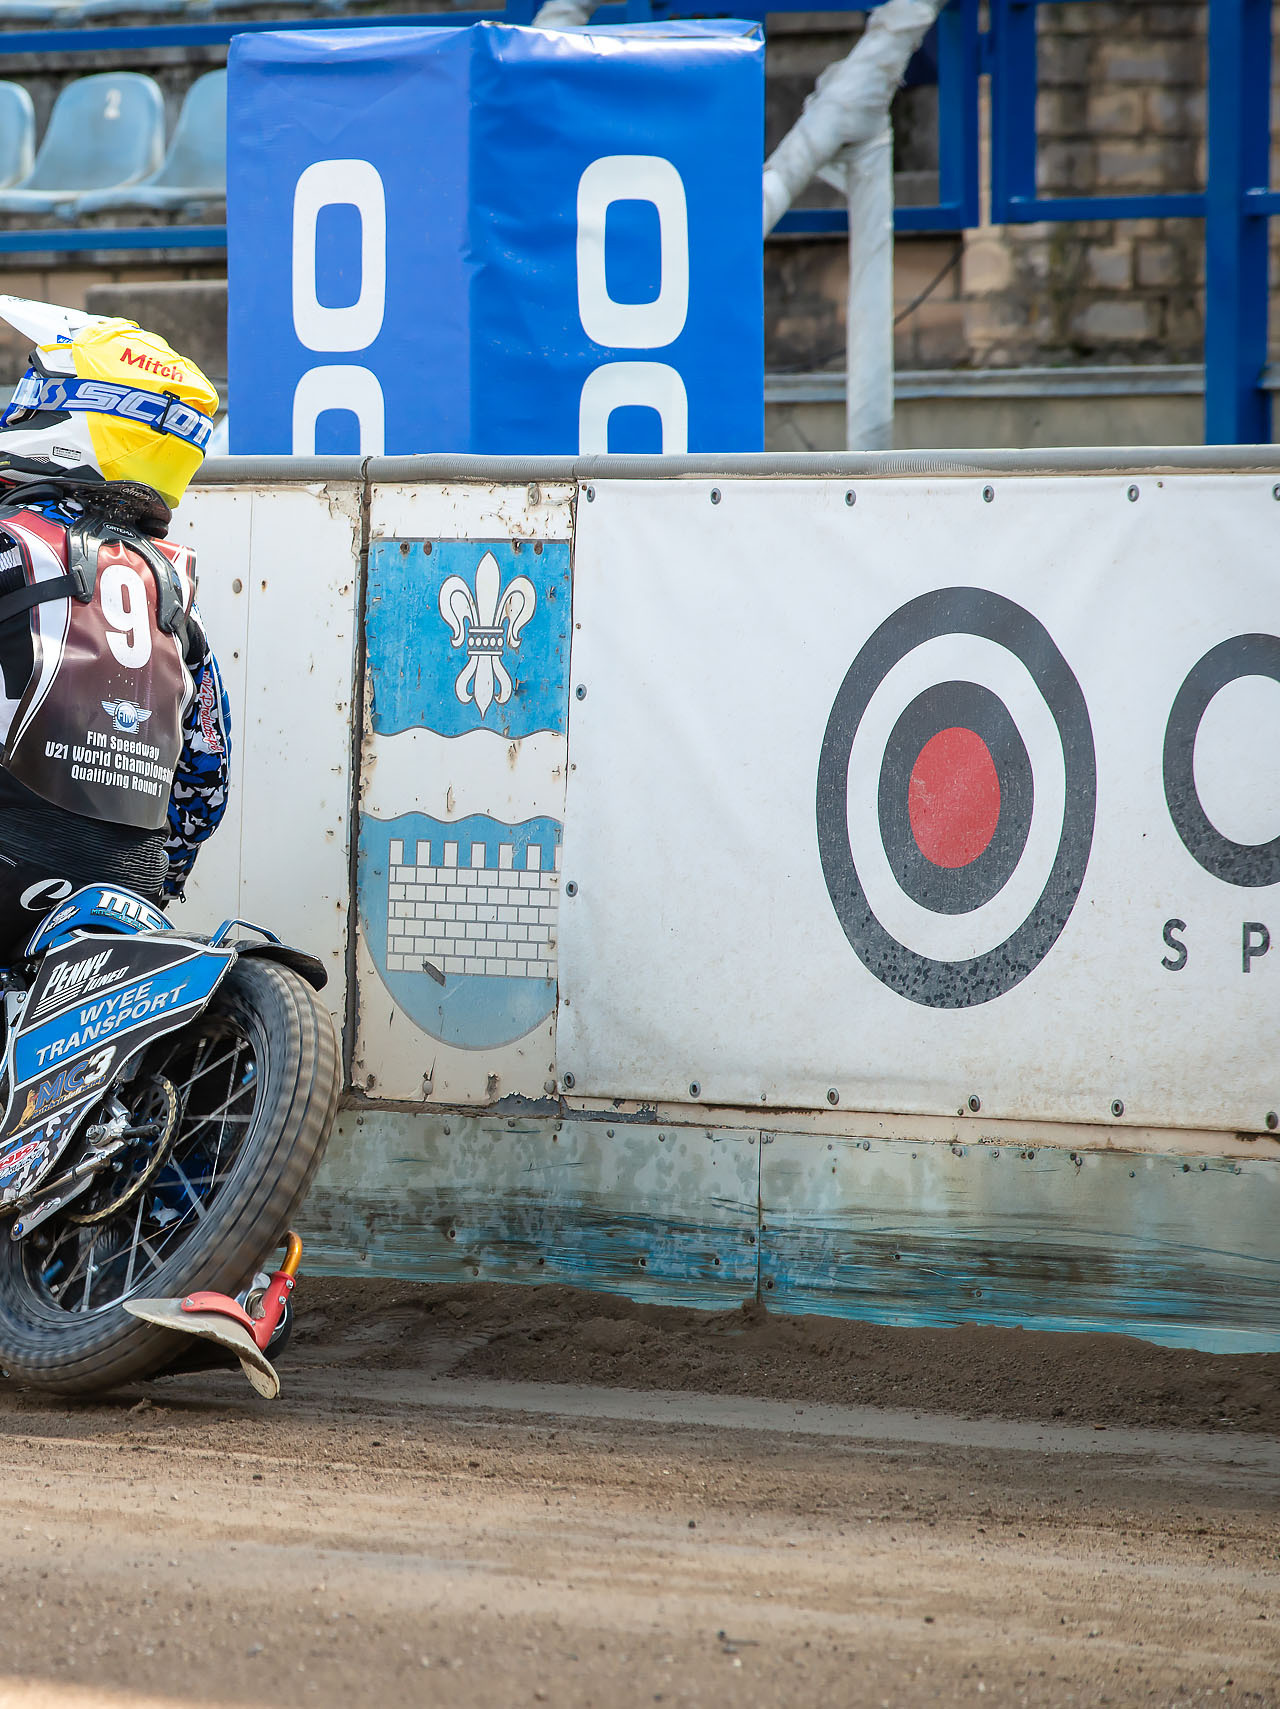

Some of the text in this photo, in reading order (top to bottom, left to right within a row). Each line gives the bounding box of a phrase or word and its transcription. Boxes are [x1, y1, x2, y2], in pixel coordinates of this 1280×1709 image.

[120, 347, 184, 383] Mitch
[62, 381, 214, 448] SCOT
[99, 563, 153, 669] 9
[45, 741, 68, 760] U21
[72, 745, 111, 767] World
[86, 730, 160, 761] FIM Speedway
[71, 764, 129, 790] Qualifying
[132, 776, 157, 796] Round
[40, 949, 130, 1001] PENNY TUNED
[36, 984, 188, 1067] TRANSPORT
[80, 981, 154, 1026] WYEE
